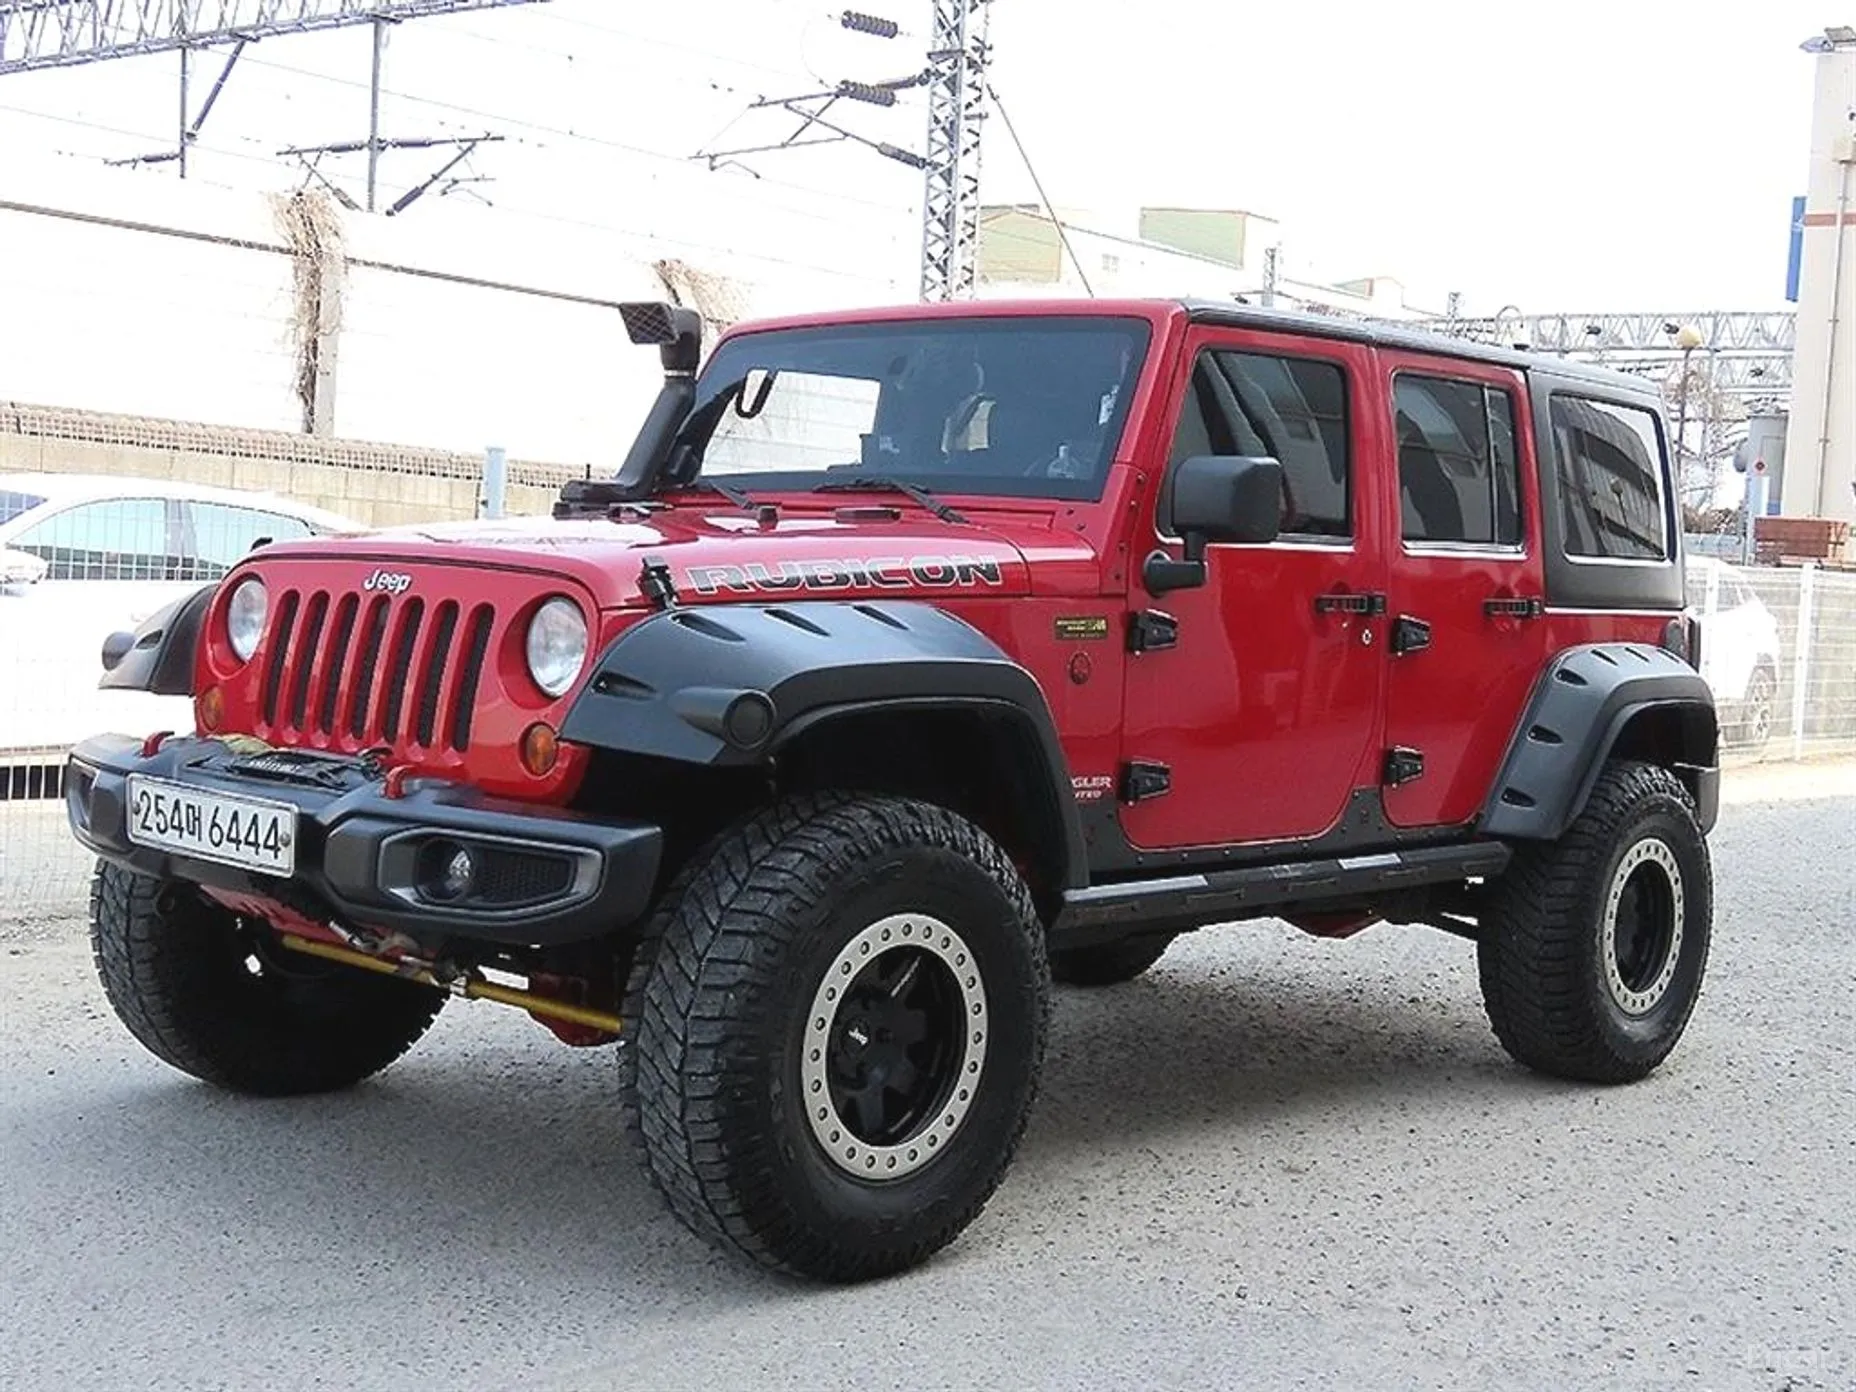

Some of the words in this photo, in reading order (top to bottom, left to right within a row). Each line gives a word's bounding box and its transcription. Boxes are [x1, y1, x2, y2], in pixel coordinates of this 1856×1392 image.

[363, 569, 411, 595] Jeep
[687, 555, 1004, 595] RUBICON
[139, 790, 202, 842] 254머
[208, 805, 281, 860] 6444
